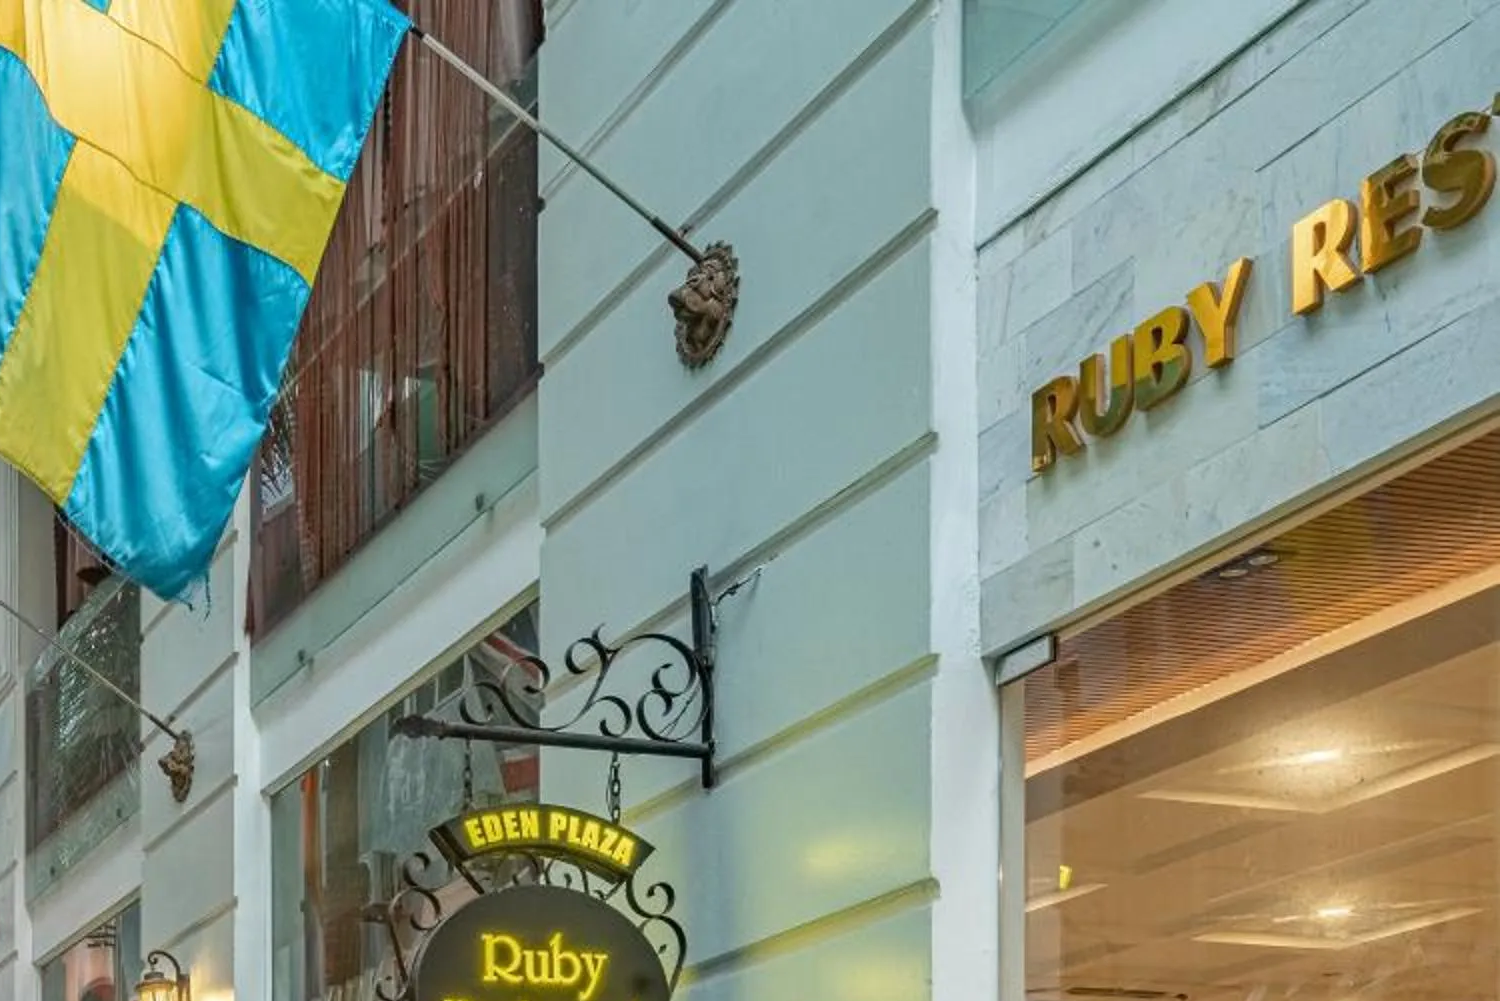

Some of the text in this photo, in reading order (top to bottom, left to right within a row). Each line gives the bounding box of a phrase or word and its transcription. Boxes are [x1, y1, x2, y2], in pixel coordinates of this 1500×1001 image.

[1031, 92, 1500, 474] RUBY RES
[464, 810, 637, 868] EDEN PLAZA
[480, 932, 608, 1001] Ruby
